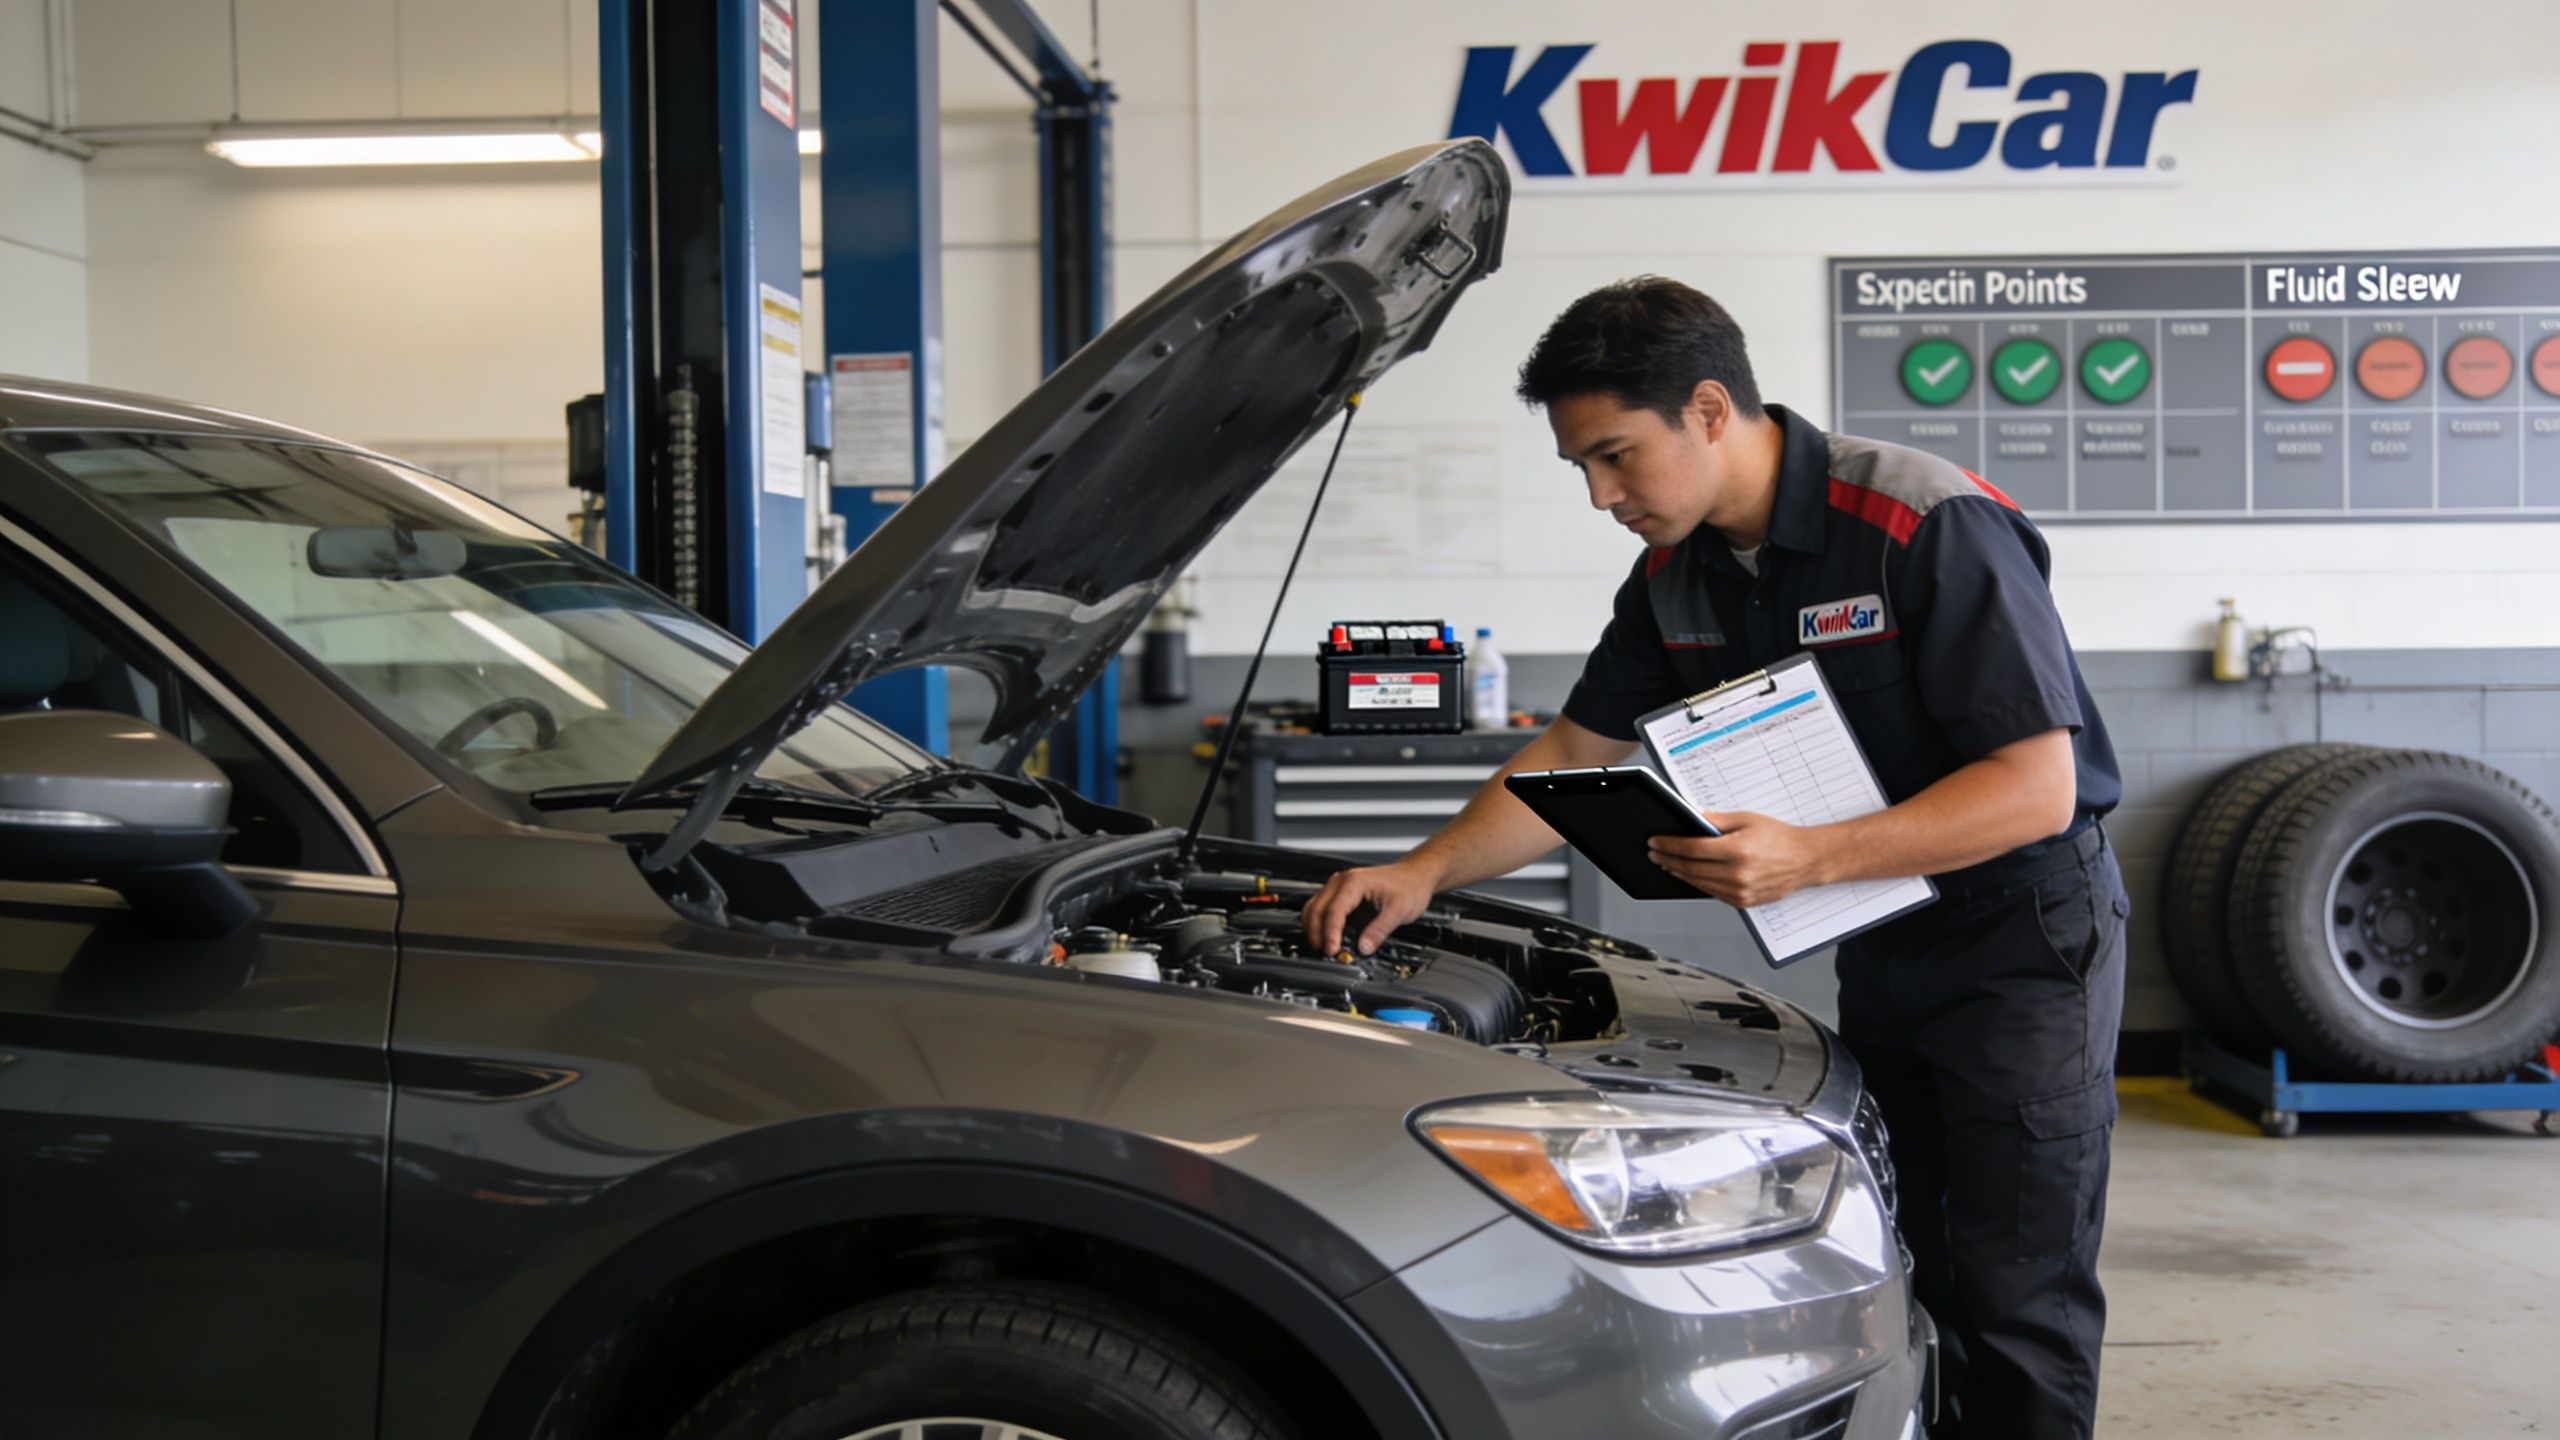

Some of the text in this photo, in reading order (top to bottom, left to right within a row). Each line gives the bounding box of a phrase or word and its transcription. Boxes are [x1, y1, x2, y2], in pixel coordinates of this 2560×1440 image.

[1446, 40, 2199, 177] KwikCar
[1985, 269, 2088, 305] Points
[2267, 265, 2462, 303] Fluid Sleew
